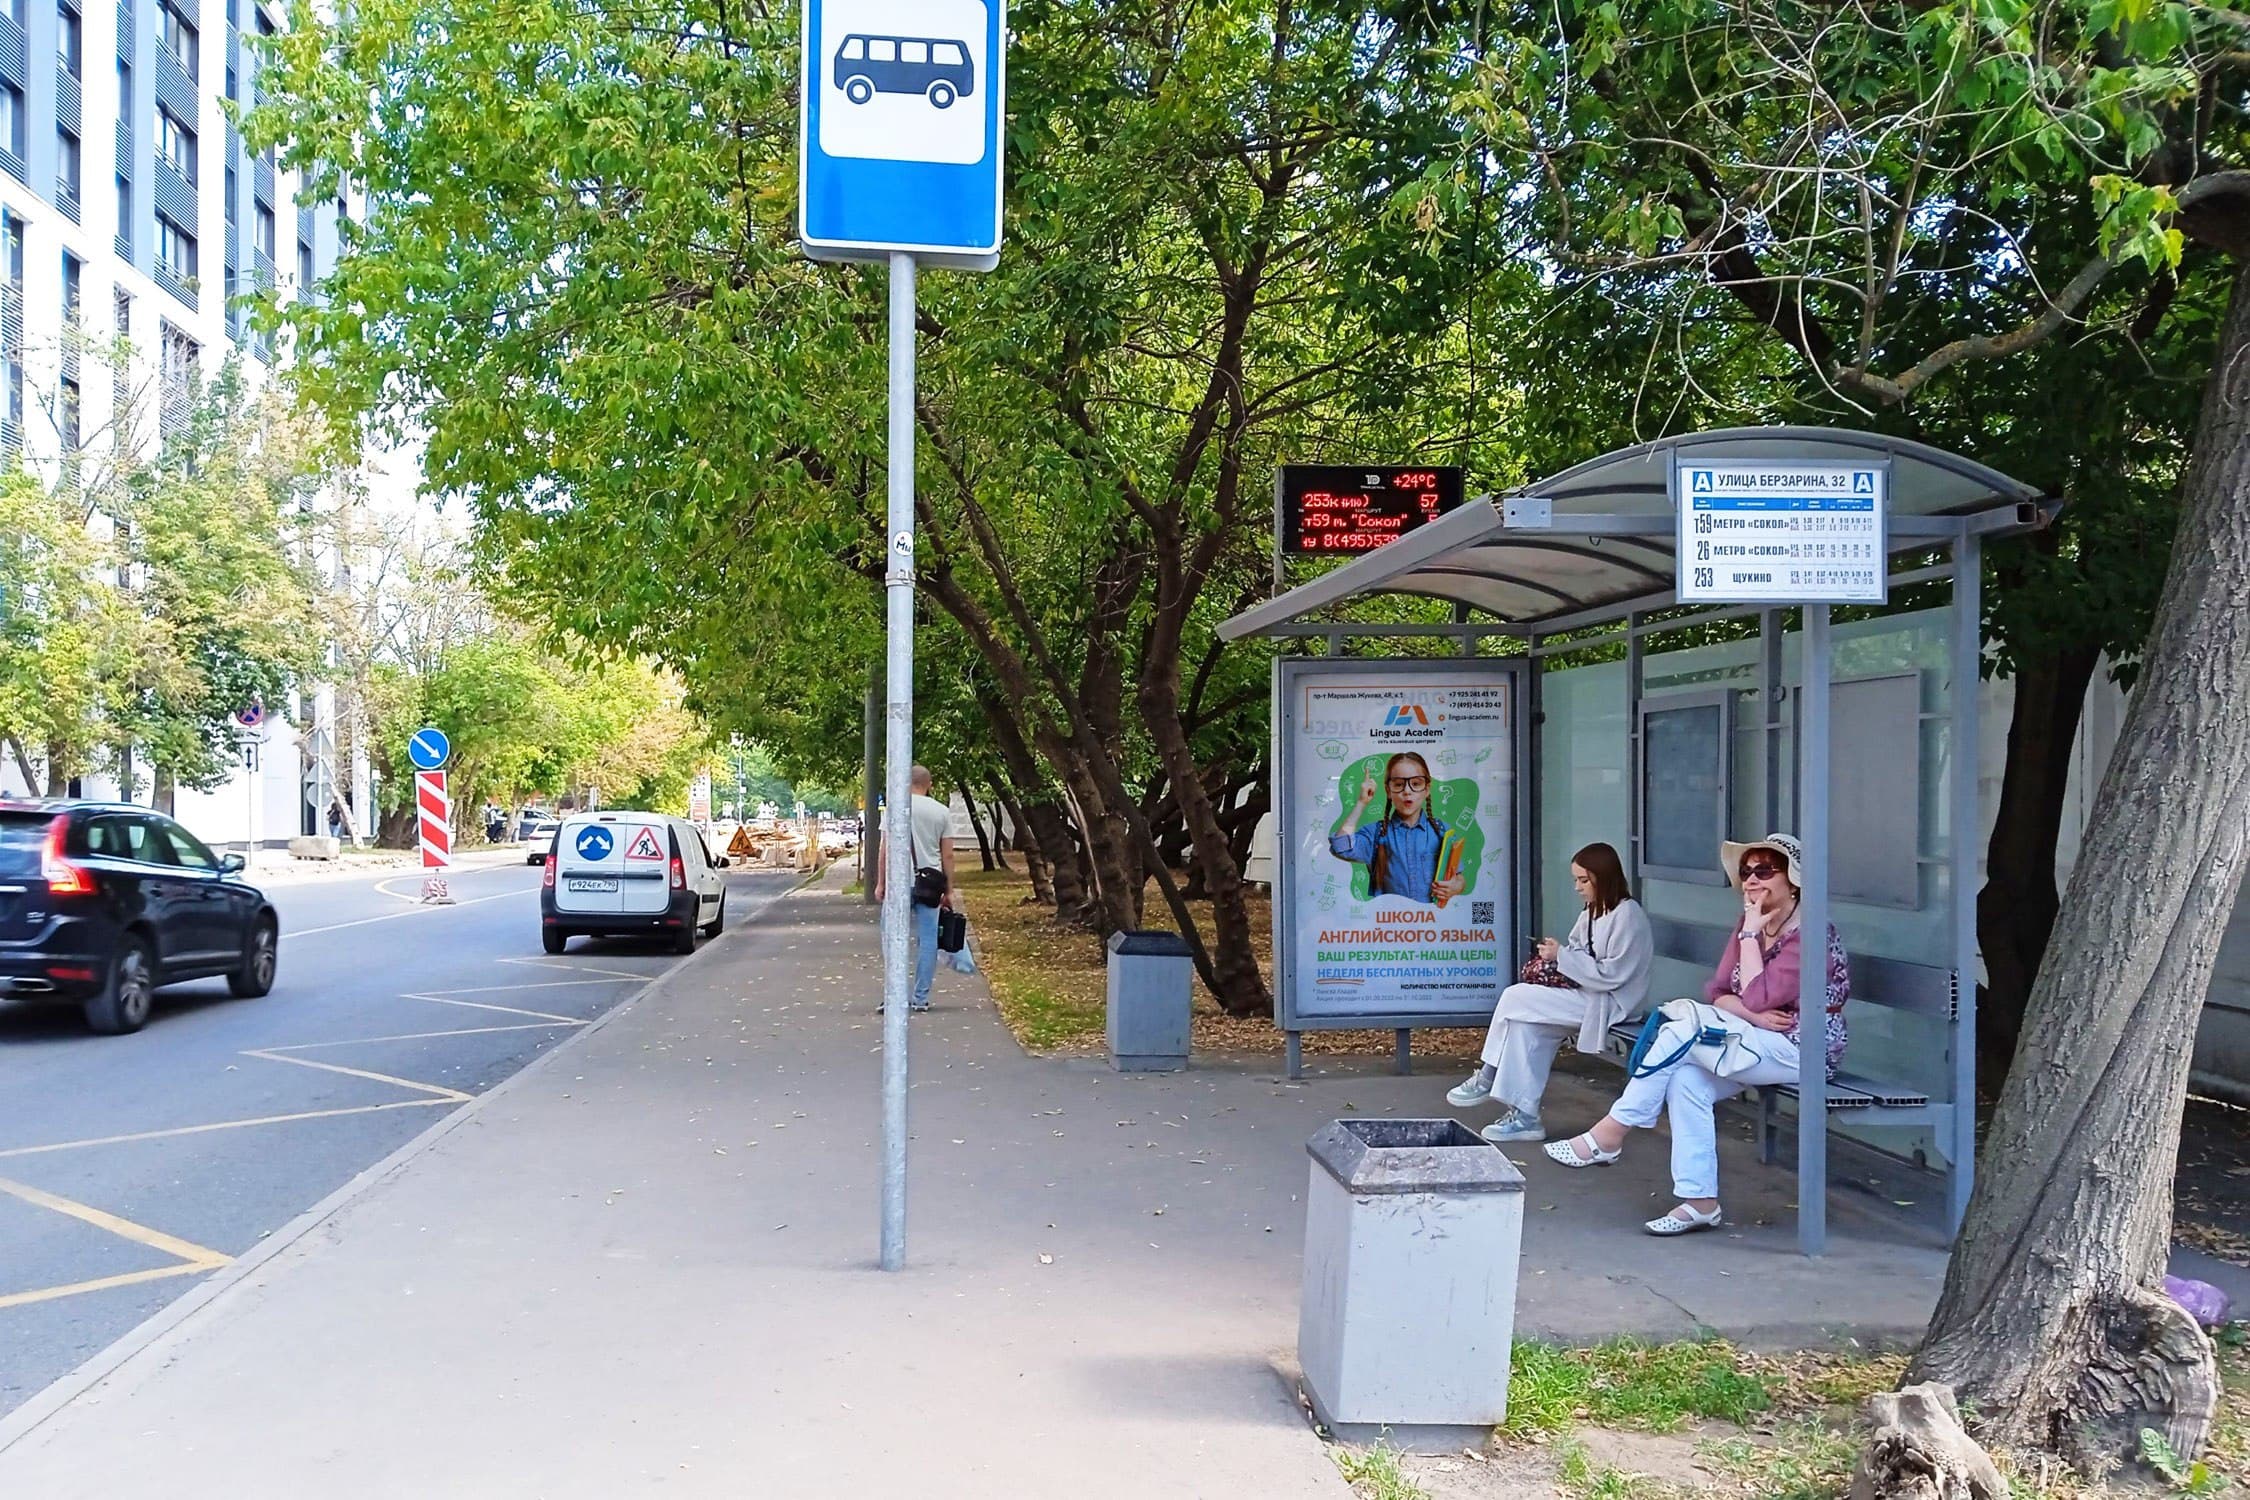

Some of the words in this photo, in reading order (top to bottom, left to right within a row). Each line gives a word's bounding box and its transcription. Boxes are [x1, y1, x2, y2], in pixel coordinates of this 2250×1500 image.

[1393, 474, 1436, 488] +24°C
[1718, 474, 1757, 488] УЛИЦА
[1760, 475, 1828, 488] БЕРЗАРИНА,
[1831, 475, 1846, 487] 32
[1420, 493, 1438, 507] 57
[1304, 513, 1330, 527] т59
[1351, 513, 1408, 527] "Сокол"
[1713, 519, 1745, 529] МЕТРО
[1748, 519, 1790, 529] «СОКОЛ»
[1697, 540, 1710, 561] 26
[1713, 545, 1746, 556] МЕТРО
[1748, 545, 1790, 556] «СОКОЛ»
[1694, 567, 1713, 588] 253
[1732, 572, 1772, 584] ЩУКИНО
[1369, 728, 1401, 739] Lingua
[1376, 911, 1436, 924] ШКОЛА
[1318, 927, 1437, 943] АНГЛИЙСКОГО
[1440, 929, 1496, 943] ЯЗЫКА
[1317, 950, 1345, 962] ВАШ
[1460, 949, 1497, 962] ЦЕЛЬ!
[1317, 967, 1364, 979] НЕДЕЛЯ
[1366, 967, 1444, 978] БЕСПЛАТНЫХ
[1446, 967, 1497, 977] УРОКОВ!
